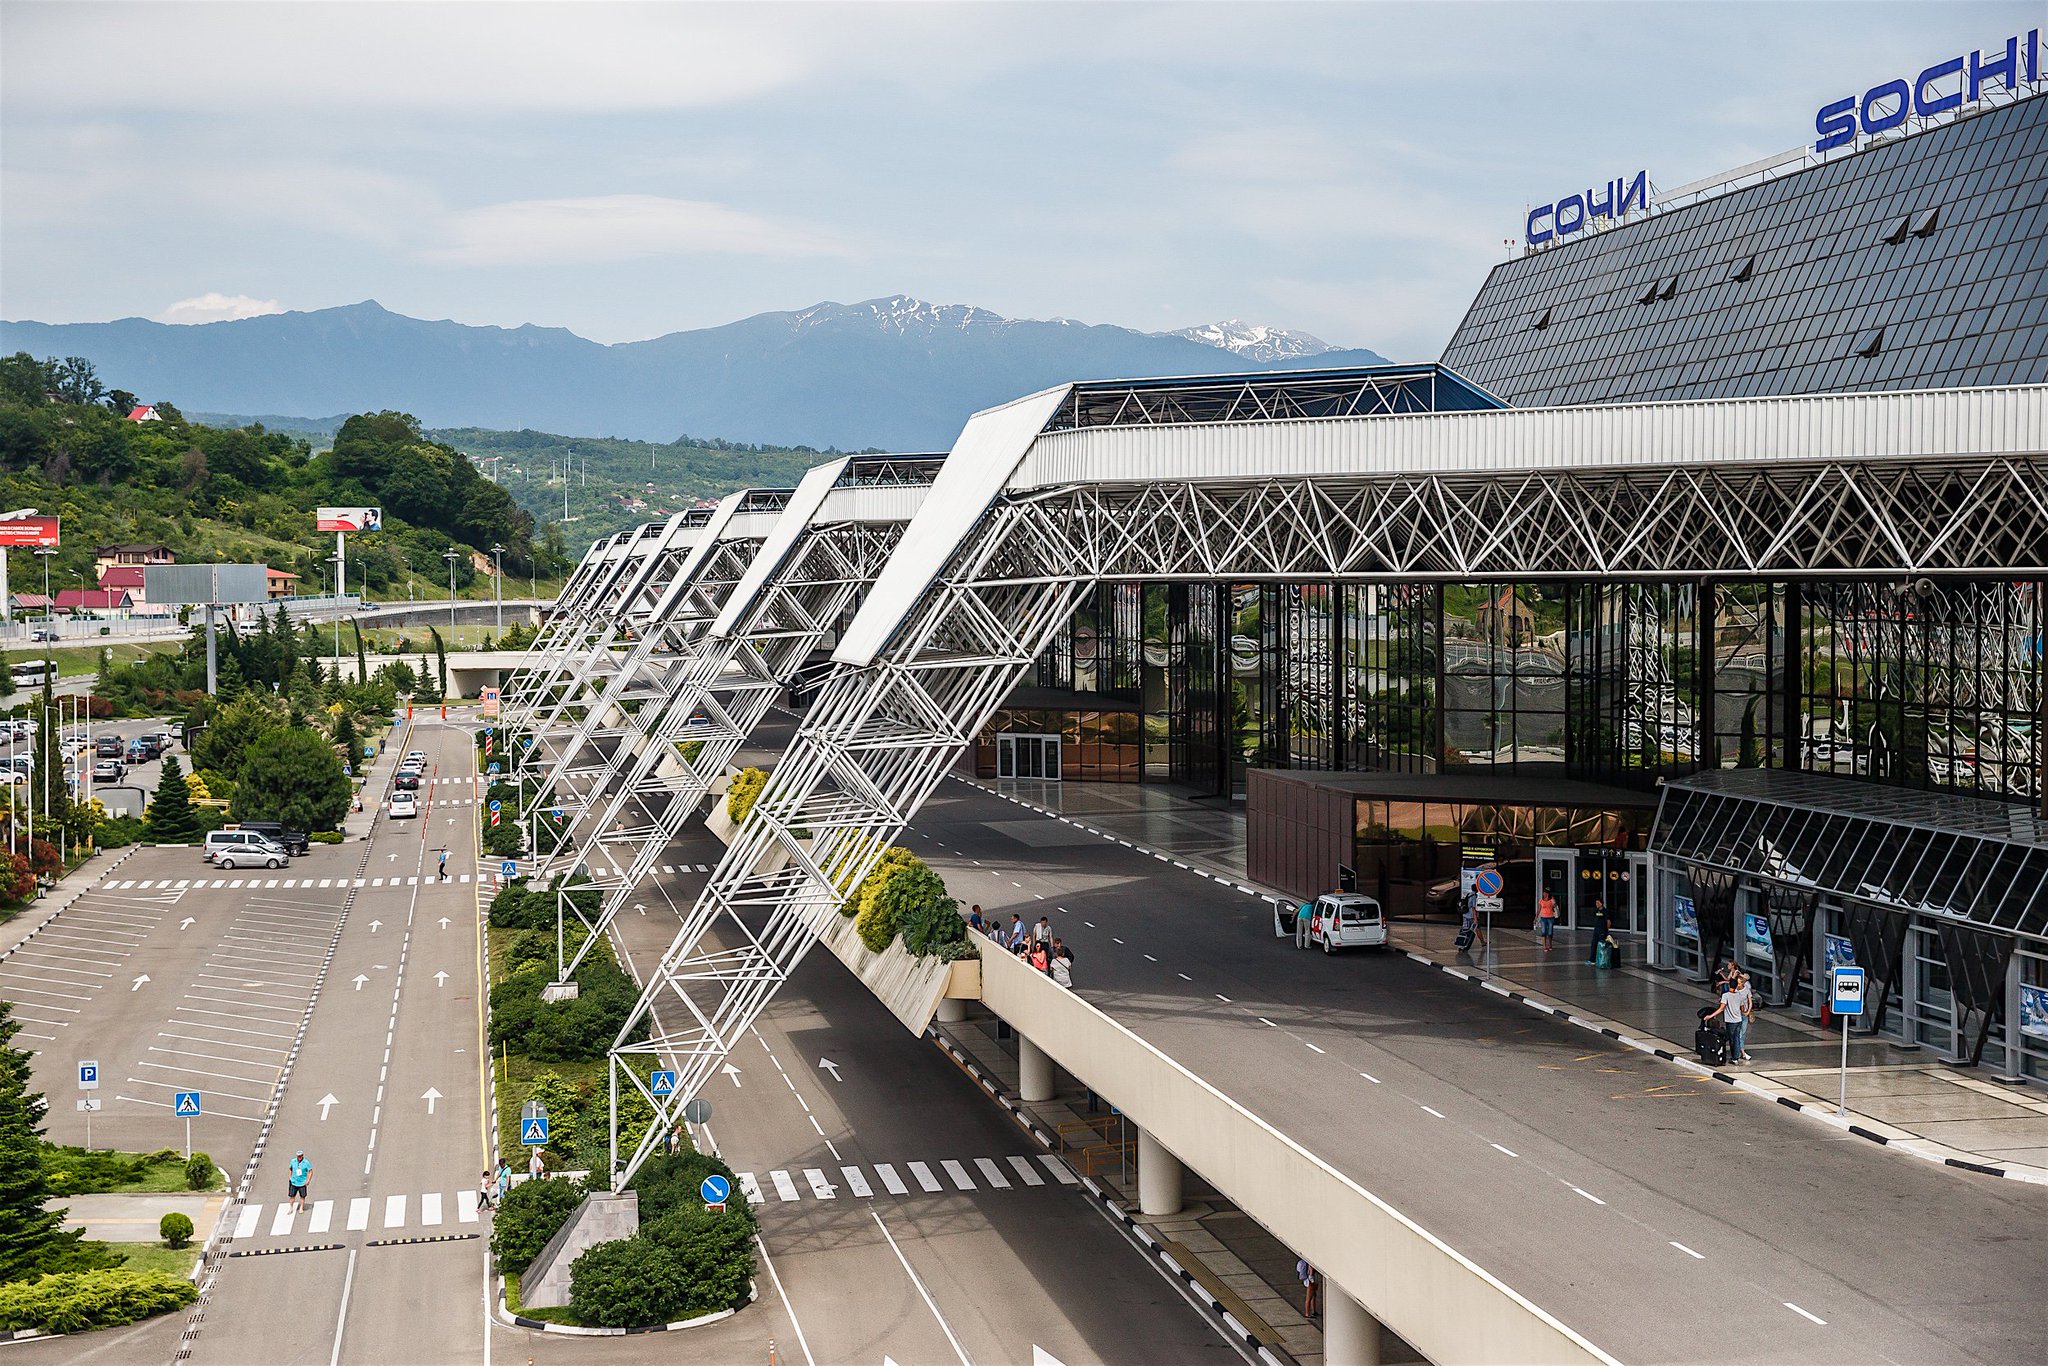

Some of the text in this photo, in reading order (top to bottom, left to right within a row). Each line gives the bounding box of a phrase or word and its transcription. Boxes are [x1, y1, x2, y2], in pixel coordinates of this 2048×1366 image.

[1815, 27, 2043, 154] SOCHI
[1527, 169, 1650, 245] СОЧИ
[85, 1068, 94, 1080] P
